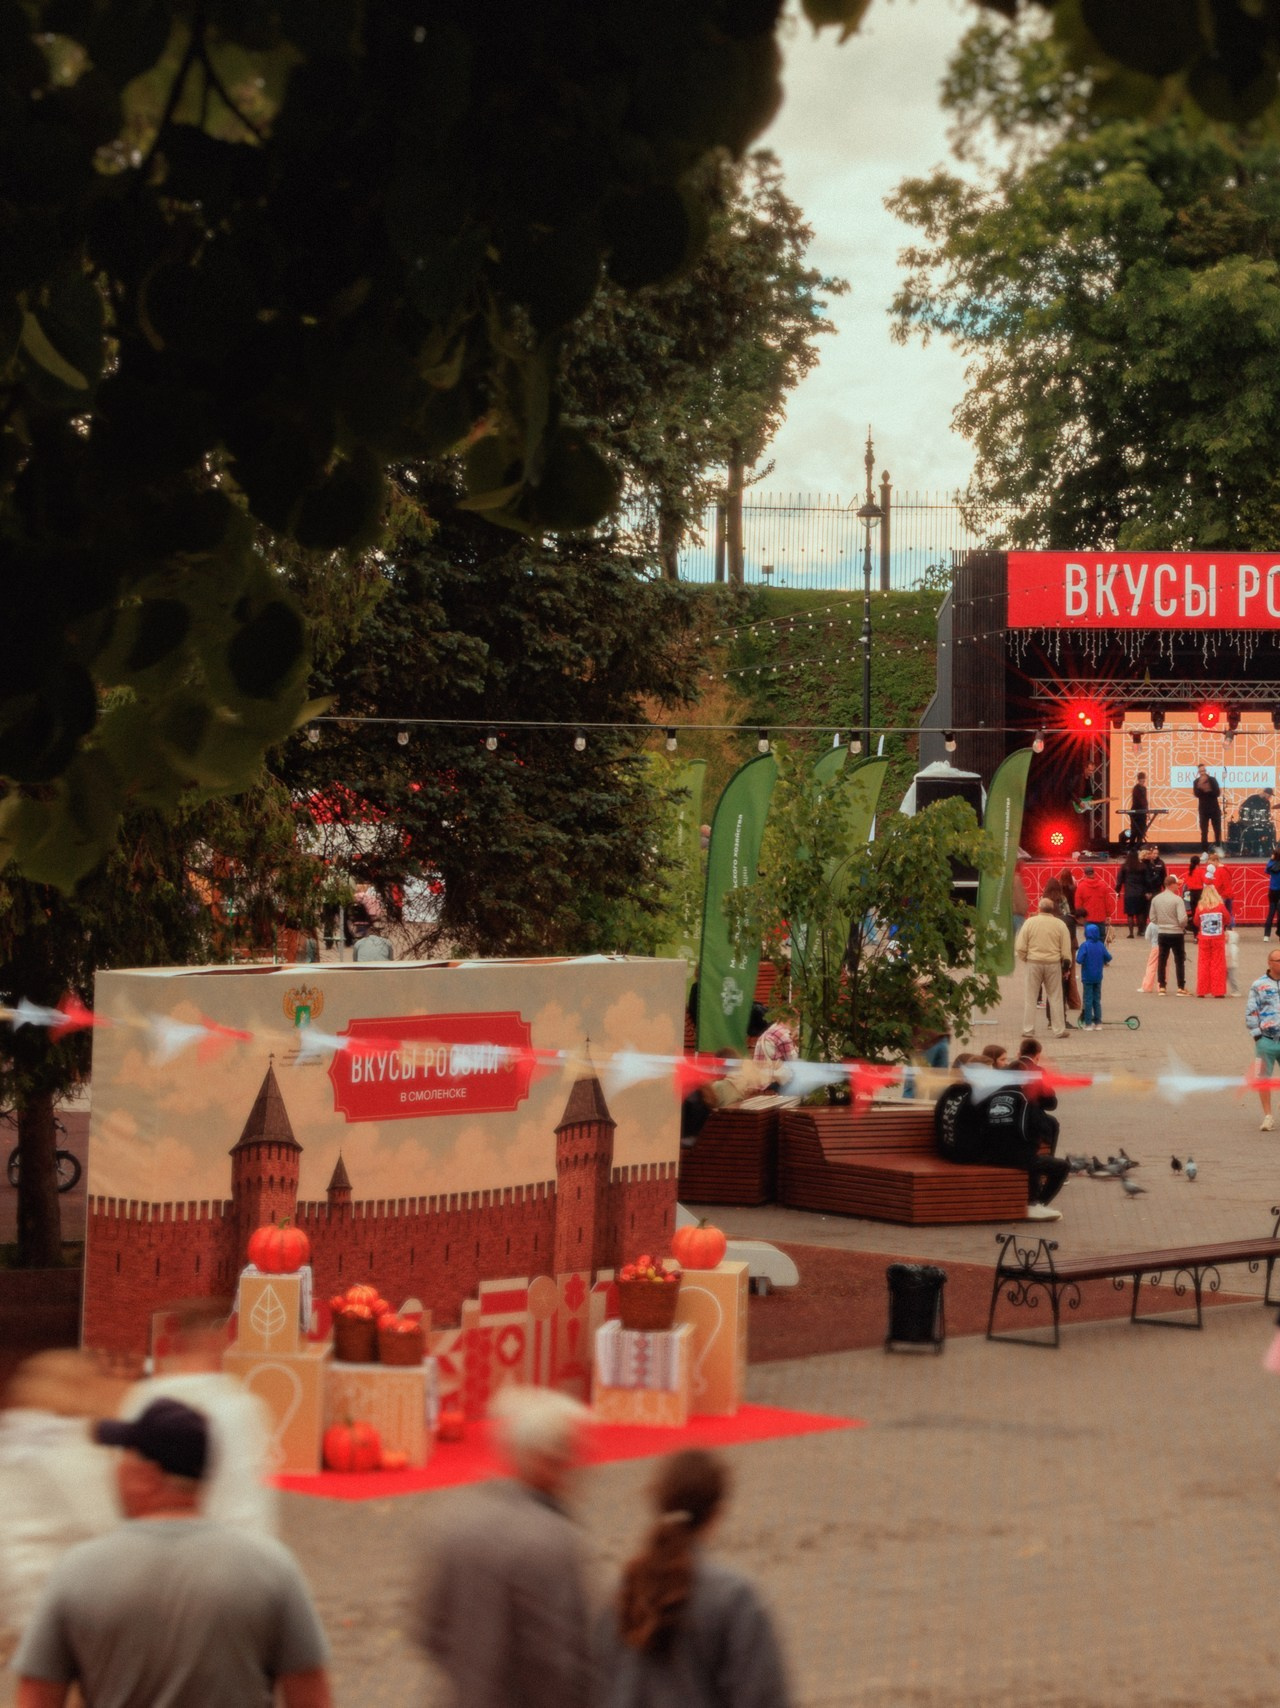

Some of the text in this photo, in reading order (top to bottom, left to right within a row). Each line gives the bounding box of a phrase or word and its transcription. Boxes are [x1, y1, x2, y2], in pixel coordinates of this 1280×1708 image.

[1065, 564, 1216, 617] ВКУСЫ
[1222, 771, 1268, 783] РОССИИ
[351, 1050, 416, 1083] ВКУСЫ
[400, 1088, 467, 1102] В СМОЛЕНСКЕ
